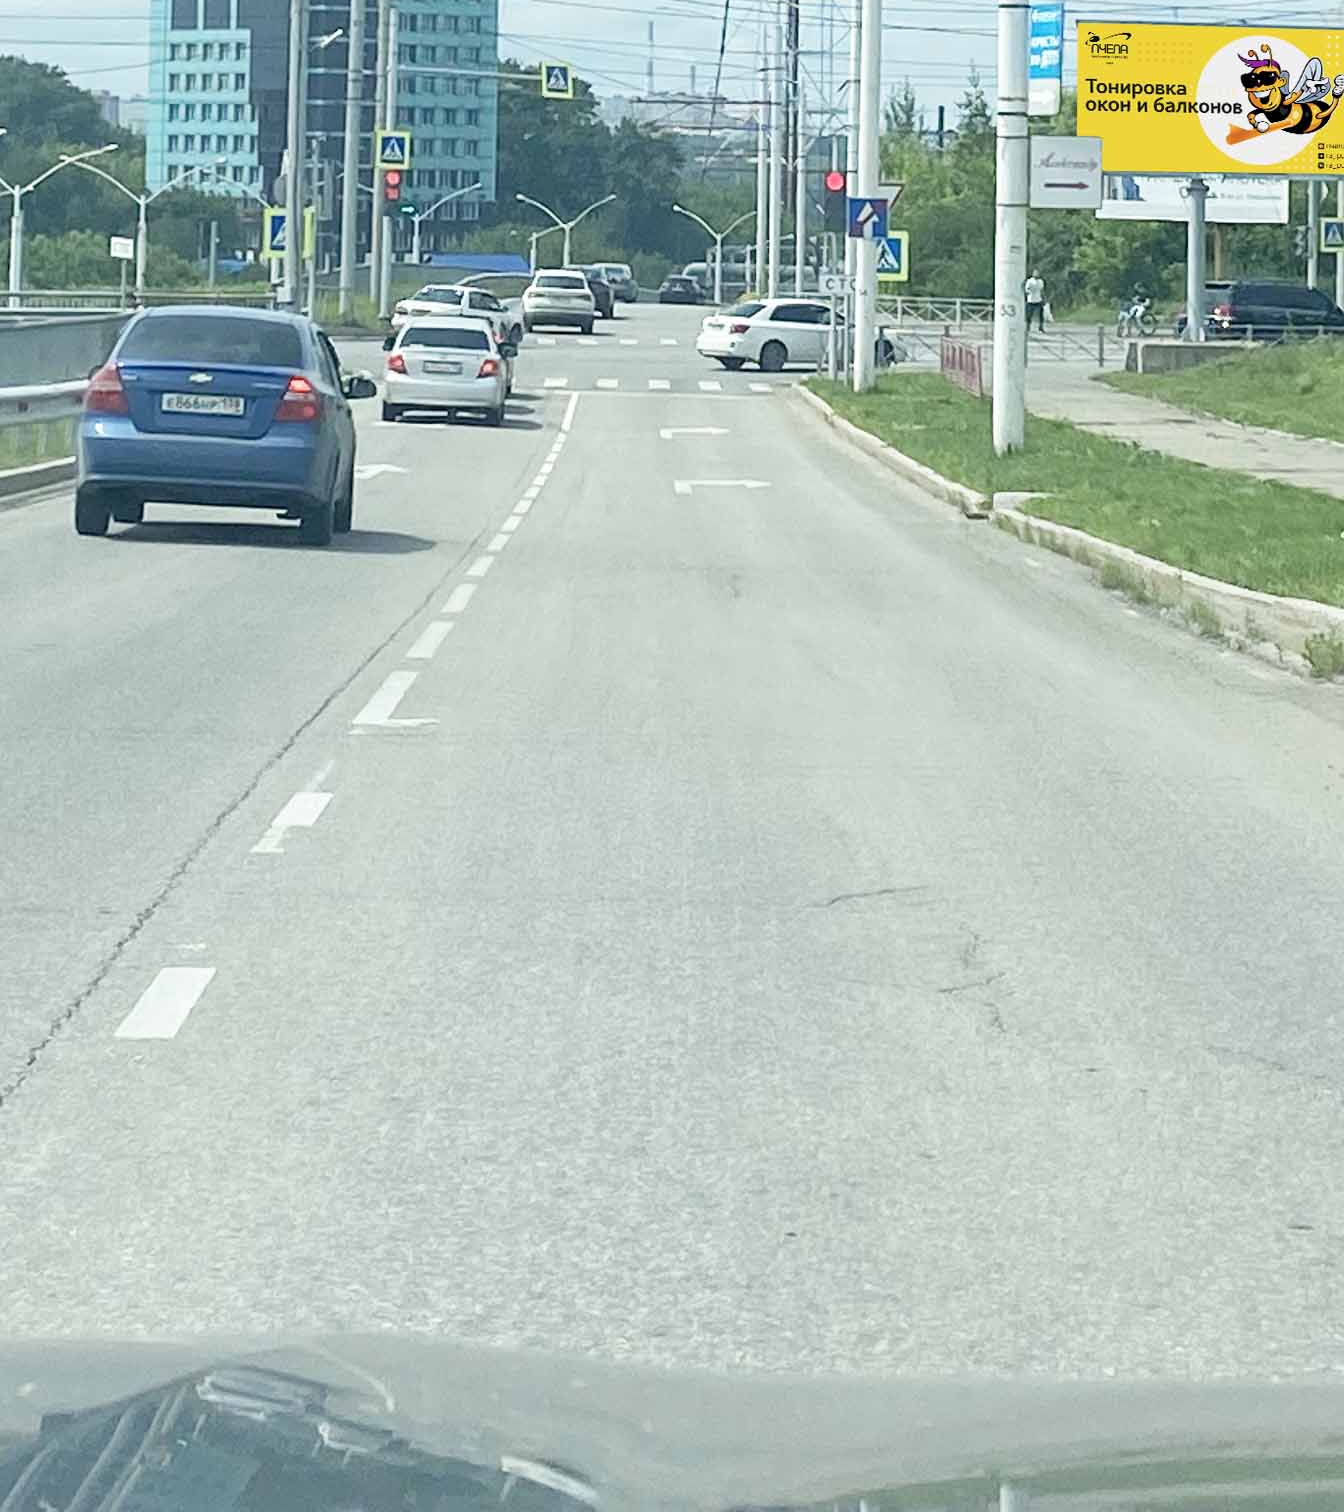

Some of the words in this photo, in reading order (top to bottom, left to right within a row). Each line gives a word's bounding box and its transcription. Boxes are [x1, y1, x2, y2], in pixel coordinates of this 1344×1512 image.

[1084, 78, 1187, 99] Тонировка
[1085, 99, 1131, 113] окон
[1137, 100, 1148, 113] и
[1153, 96, 1243, 114] балконов
[826, 277, 857, 292] СТО
